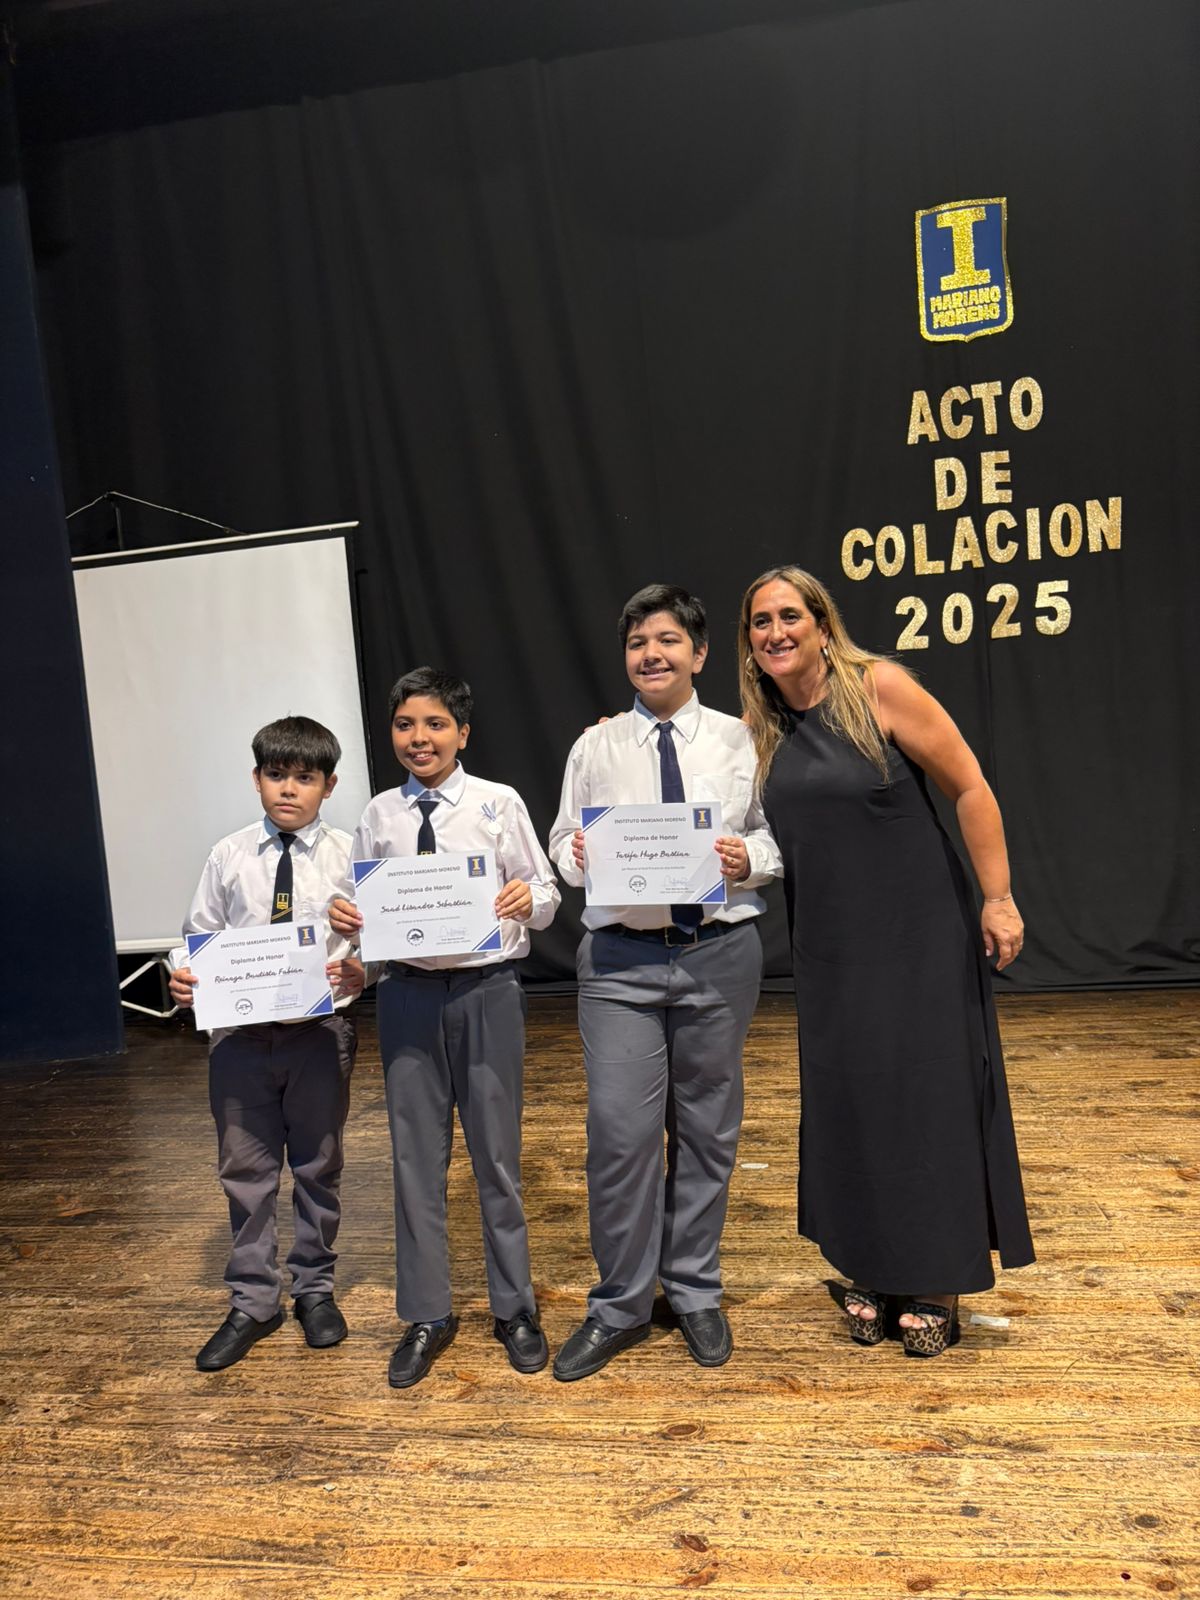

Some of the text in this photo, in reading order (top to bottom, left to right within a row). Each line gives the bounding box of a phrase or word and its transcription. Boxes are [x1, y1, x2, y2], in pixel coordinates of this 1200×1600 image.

[936, 206, 991, 291] I
[930, 286, 1001, 313] MARIANO
[933, 303, 1000, 329] MORENO
[907, 377, 1043, 445] ACTO
[934, 450, 1013, 511] DE
[841, 496, 1122, 581] COLACION
[896, 580, 1071, 650] 2025
[623, 835, 650, 843] Diploma
[640, 849, 659, 860] Hugo
[387, 869, 414, 878] INSTITUTO
[438, 865, 461, 873] MORENO
[397, 887, 424, 895] Diploma
[220, 941, 246, 949] INSTITUTO
[246, 938, 270, 947] MARIANO
[270, 935, 292, 944] MORENO
[230, 957, 256, 965] Diploma
[265, 953, 285, 961] Honor
